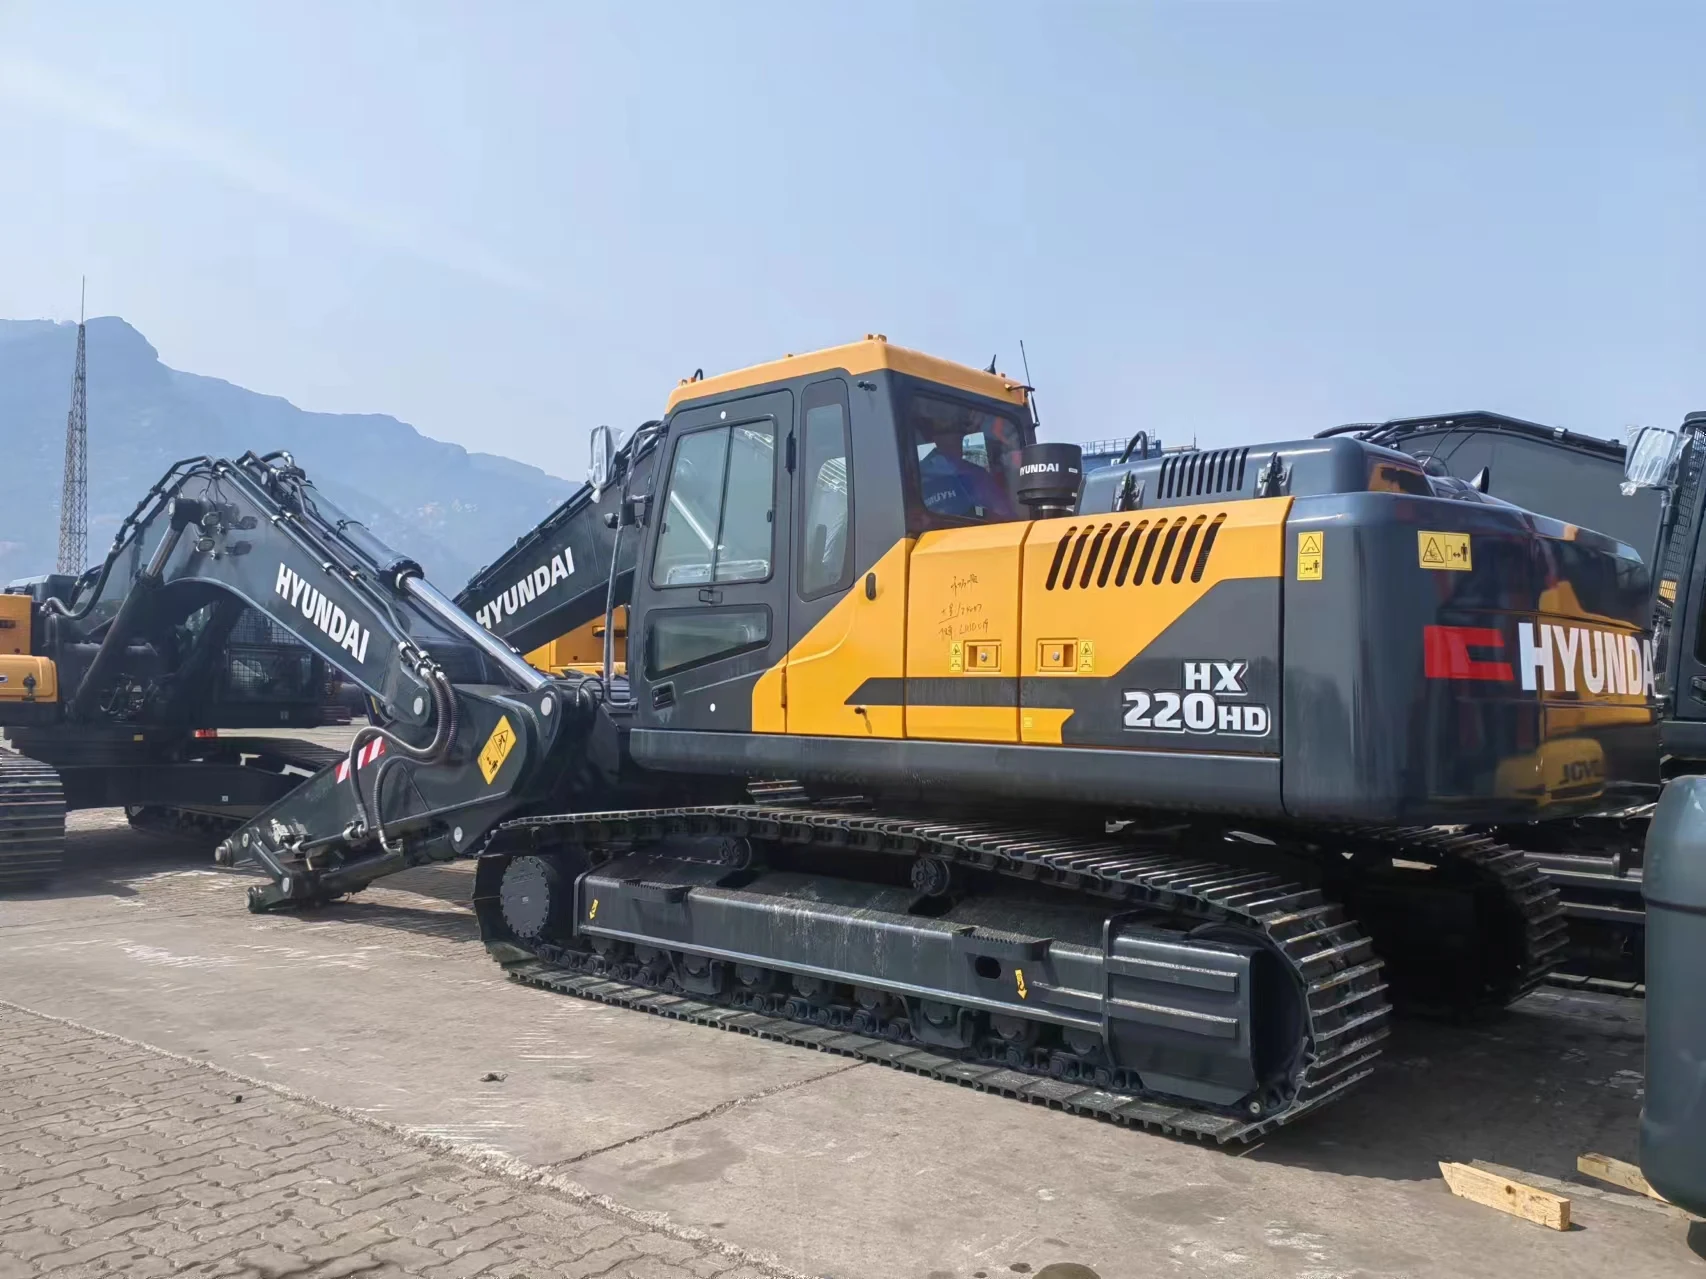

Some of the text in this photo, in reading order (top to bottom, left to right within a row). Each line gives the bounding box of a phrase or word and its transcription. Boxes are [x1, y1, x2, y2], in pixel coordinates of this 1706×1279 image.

[275, 562, 370, 664] HYUNDAI
[476, 546, 575, 630] HYUNDAI
[1184, 661, 1247, 692] HX
[1518, 622, 1656, 696] HYUNDA
[1123, 691, 1269, 733] 220HD
